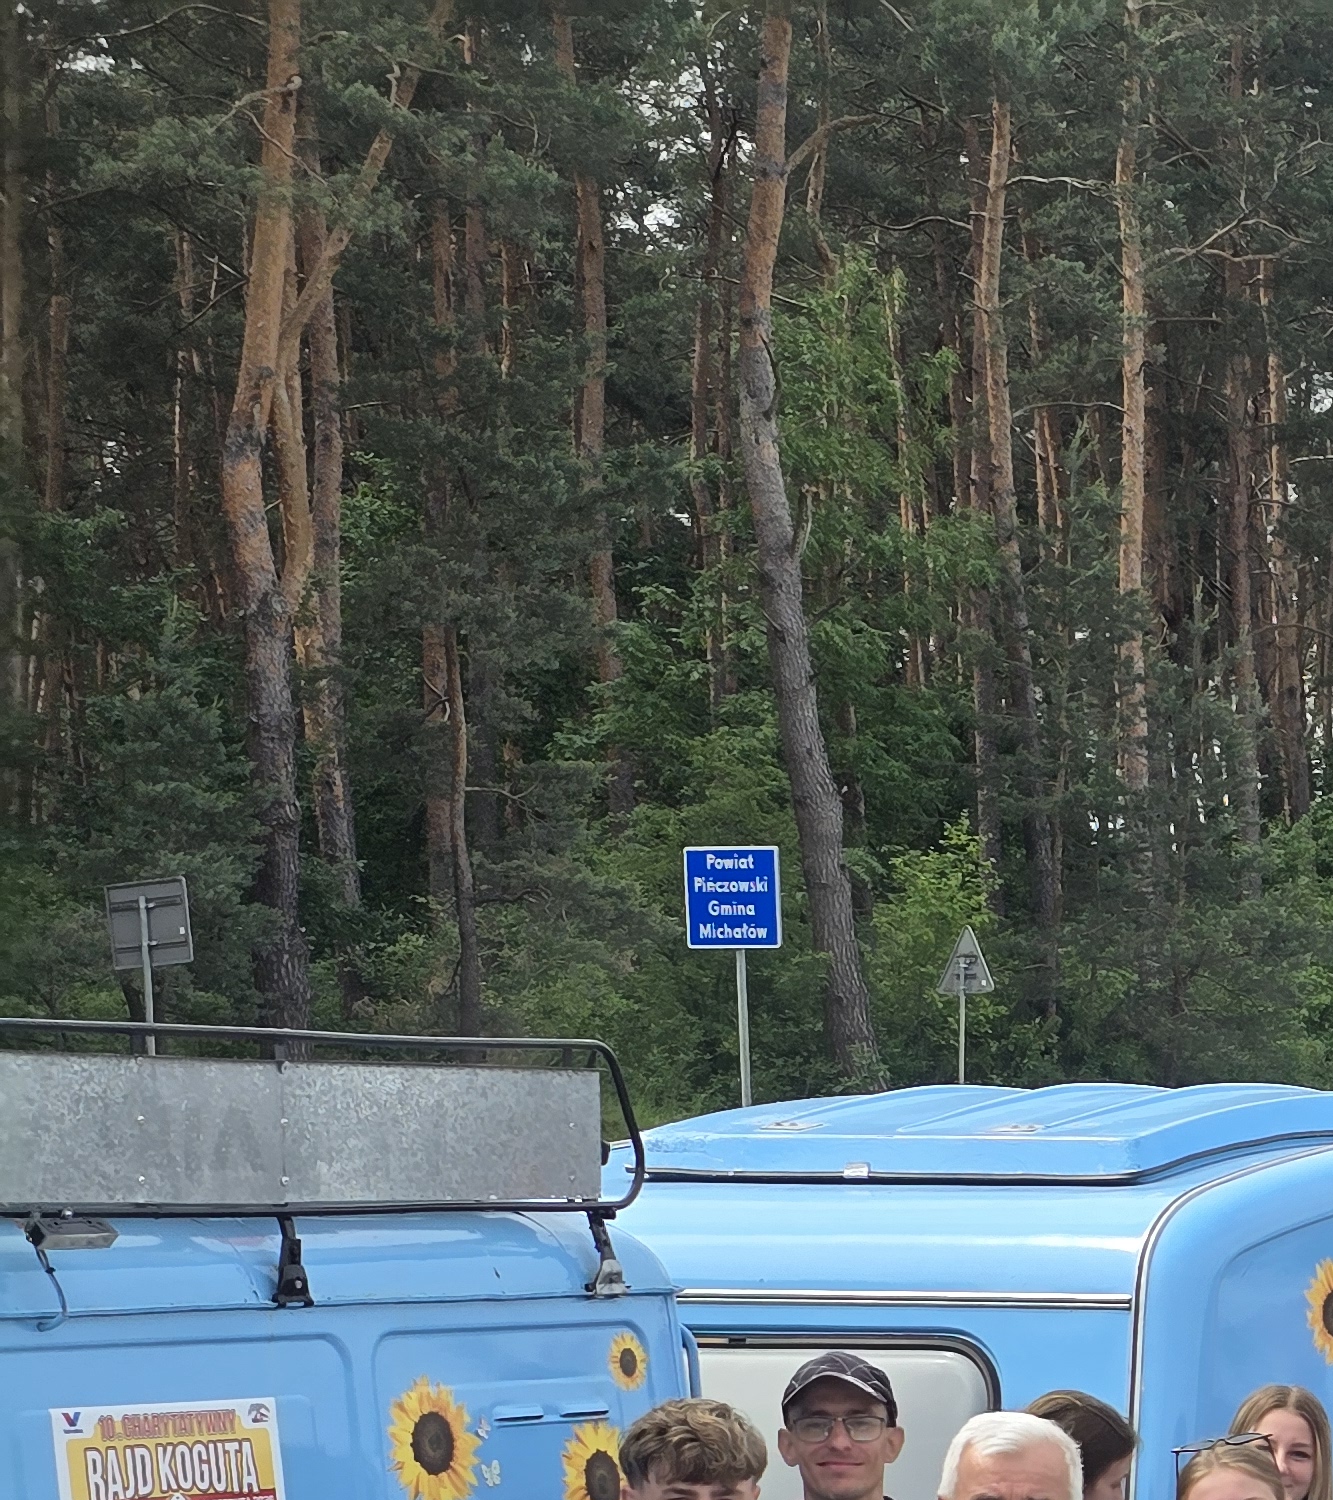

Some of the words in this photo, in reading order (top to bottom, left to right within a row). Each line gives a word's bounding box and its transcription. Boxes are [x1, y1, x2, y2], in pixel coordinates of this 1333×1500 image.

[706, 853, 755, 870] Powiat
[708, 900, 756, 916] Gmina
[699, 922, 768, 939] Michałów
[157, 1439, 260, 1493] KOGUTA
